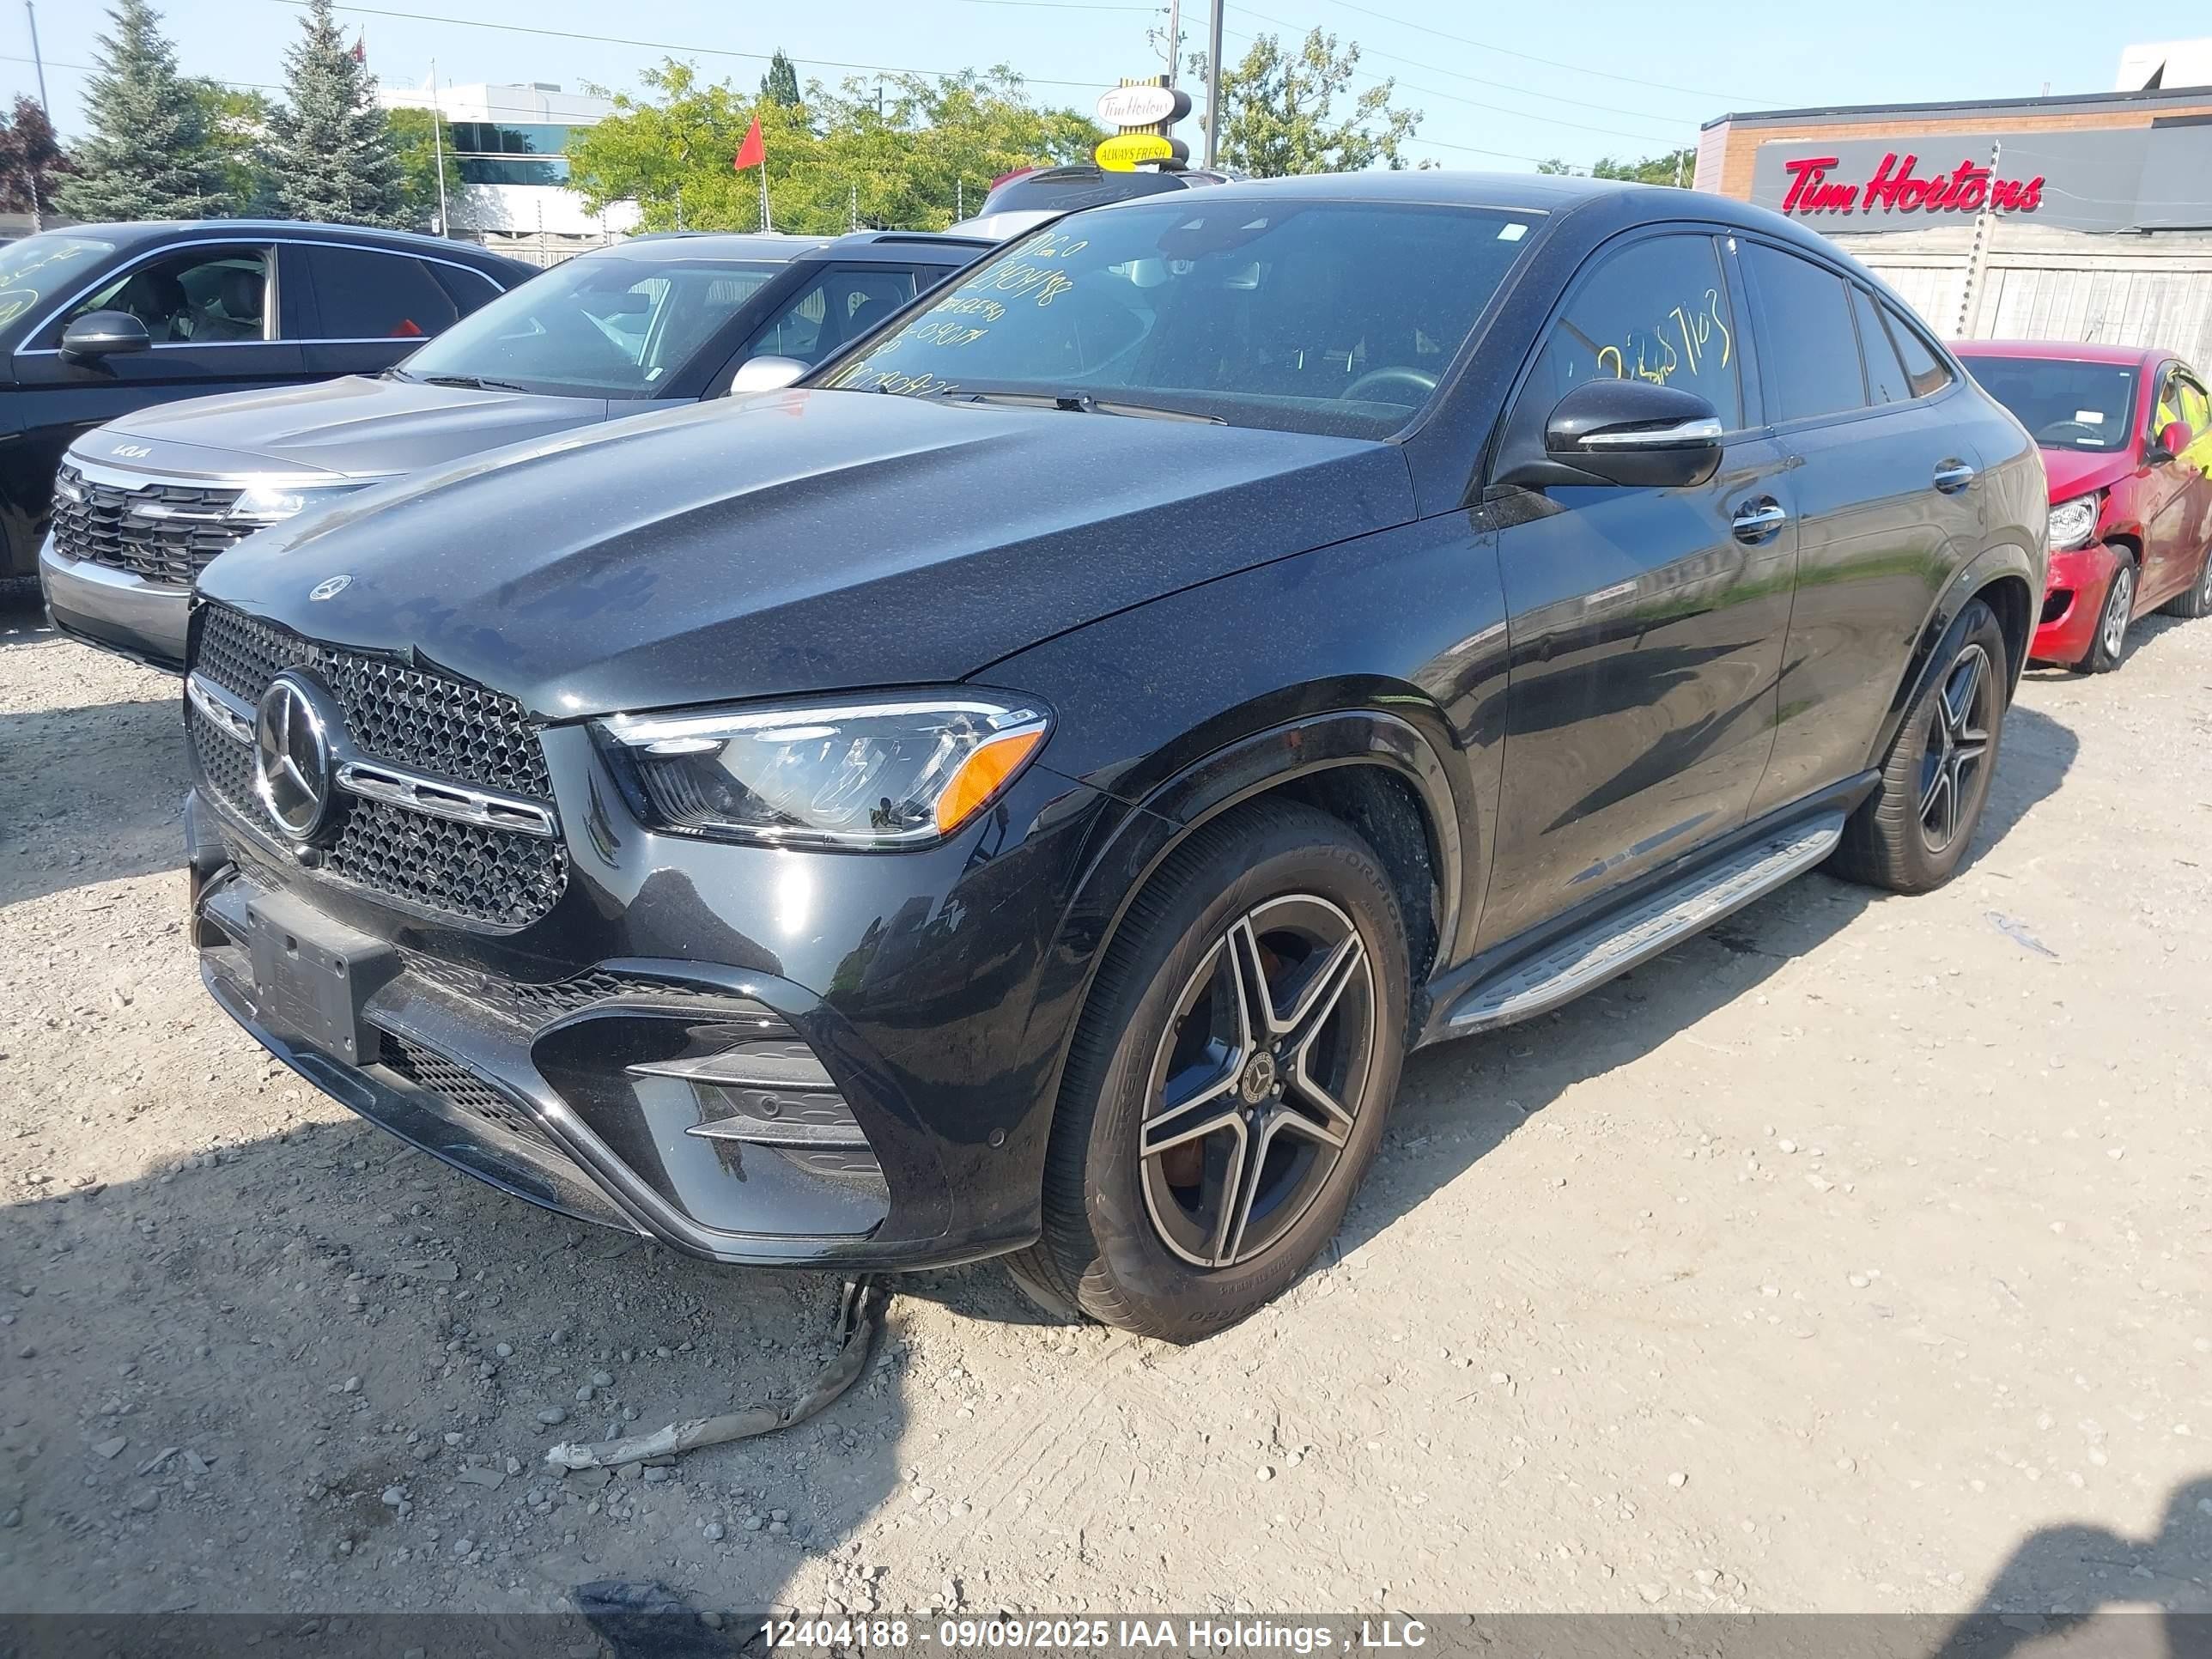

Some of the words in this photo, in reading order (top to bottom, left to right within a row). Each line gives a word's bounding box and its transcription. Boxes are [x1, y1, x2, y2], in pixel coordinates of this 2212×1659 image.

[1104, 96, 1125, 117] Tim
[1101, 147, 1135, 161] ALWAYS
[1136, 145, 1167, 160] FRESH
[1782, 156, 1858, 214] Tim
[1861, 152, 2045, 214] Hortons
